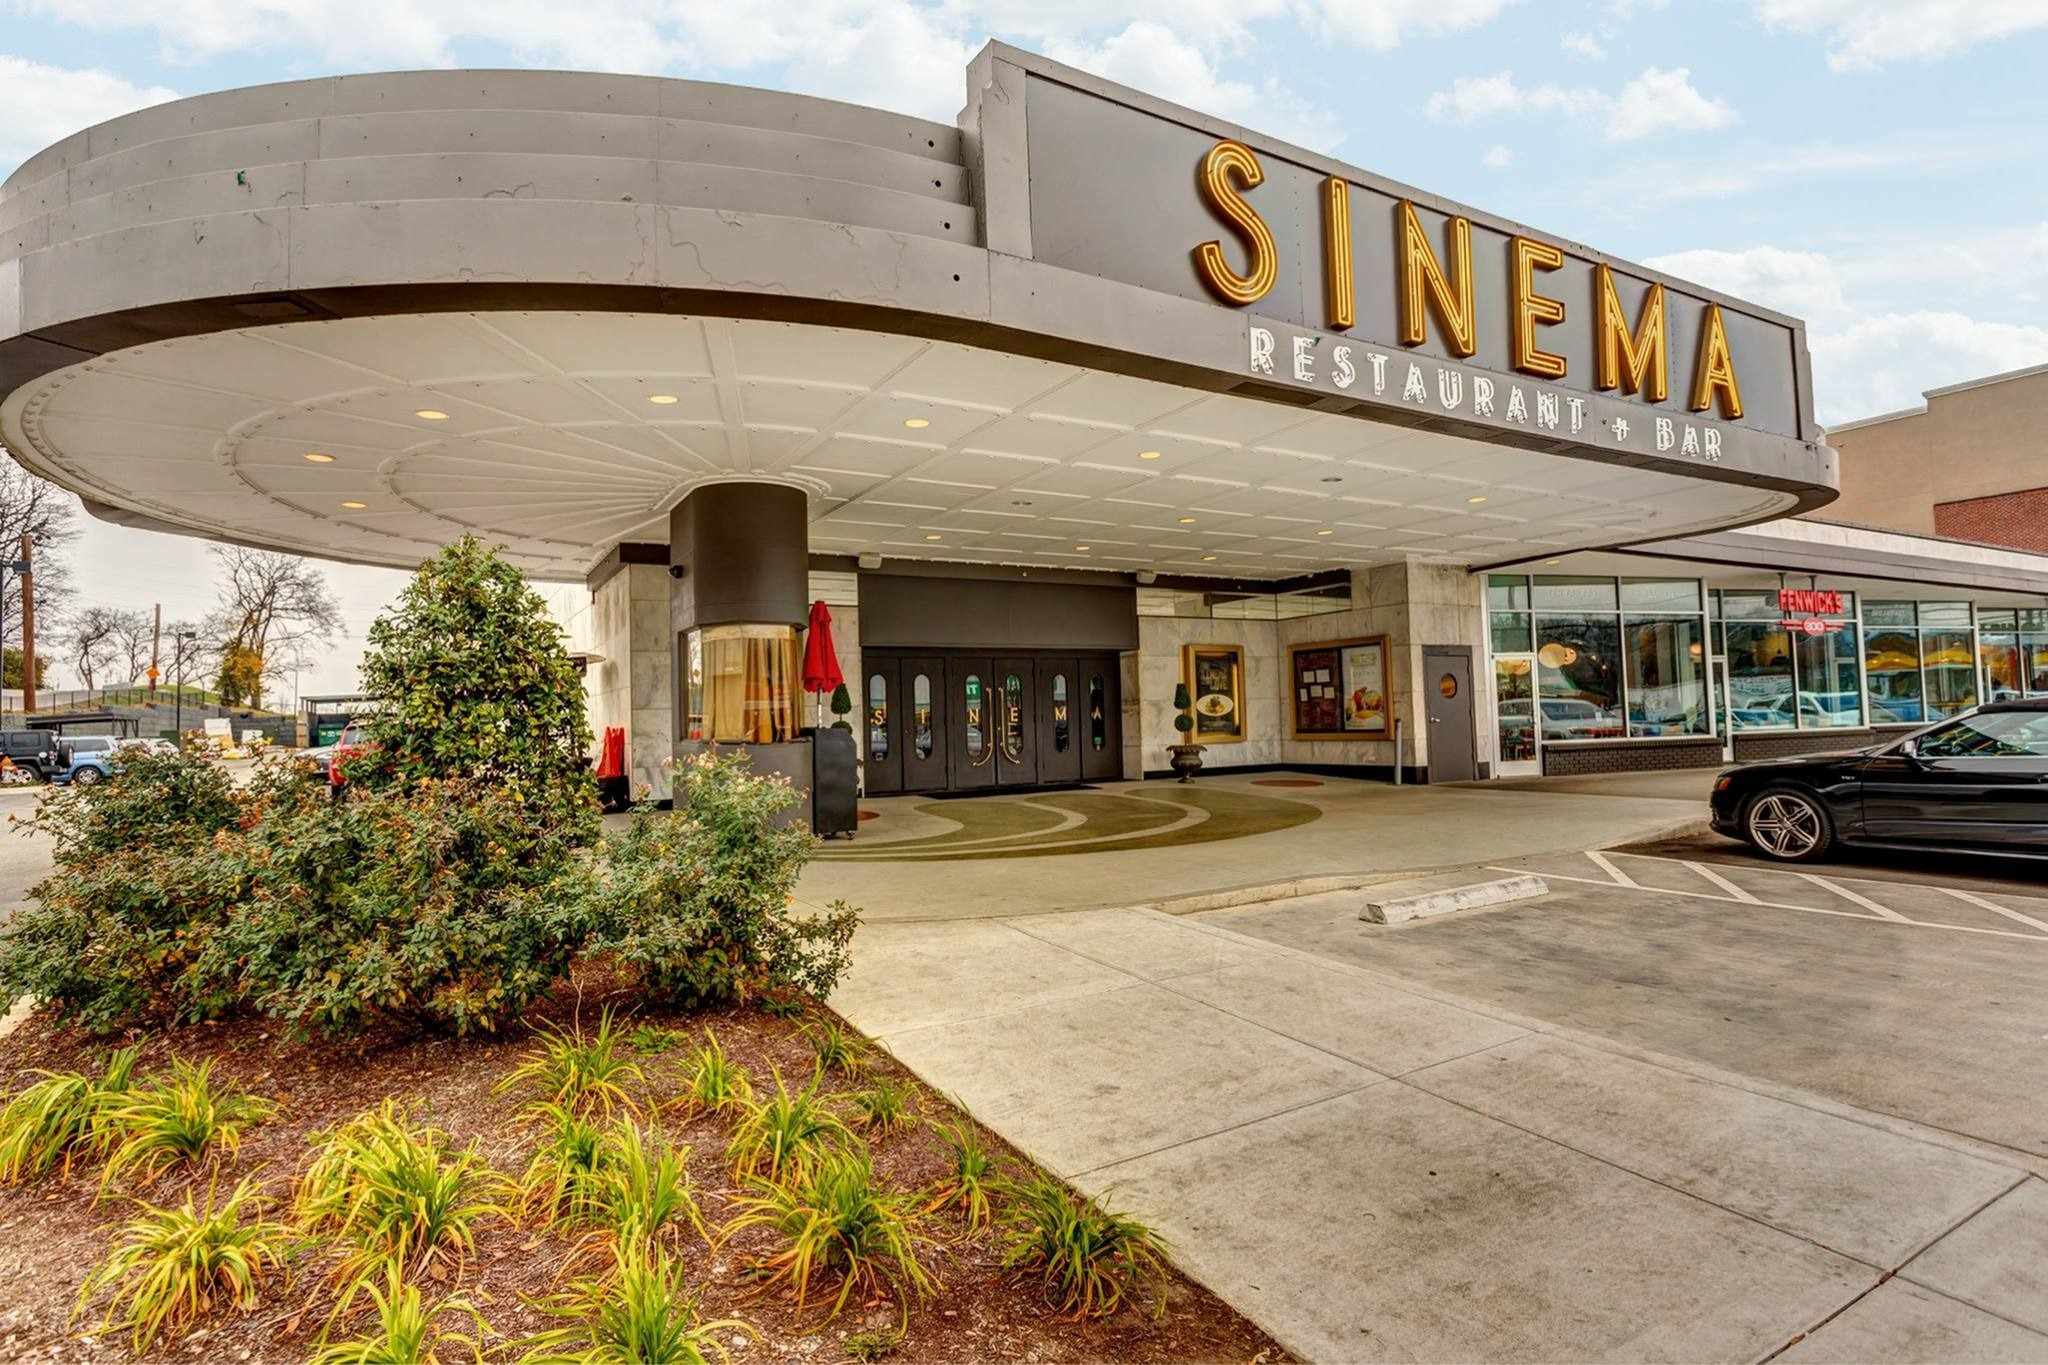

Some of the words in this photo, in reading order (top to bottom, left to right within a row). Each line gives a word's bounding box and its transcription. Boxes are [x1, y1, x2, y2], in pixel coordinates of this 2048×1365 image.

[1194, 139, 1744, 420] SINEMA
[1249, 326, 1585, 434] RESTAURANT
[1655, 416, 1722, 461] BAR
[1777, 588, 1844, 614] FENWICK'S
